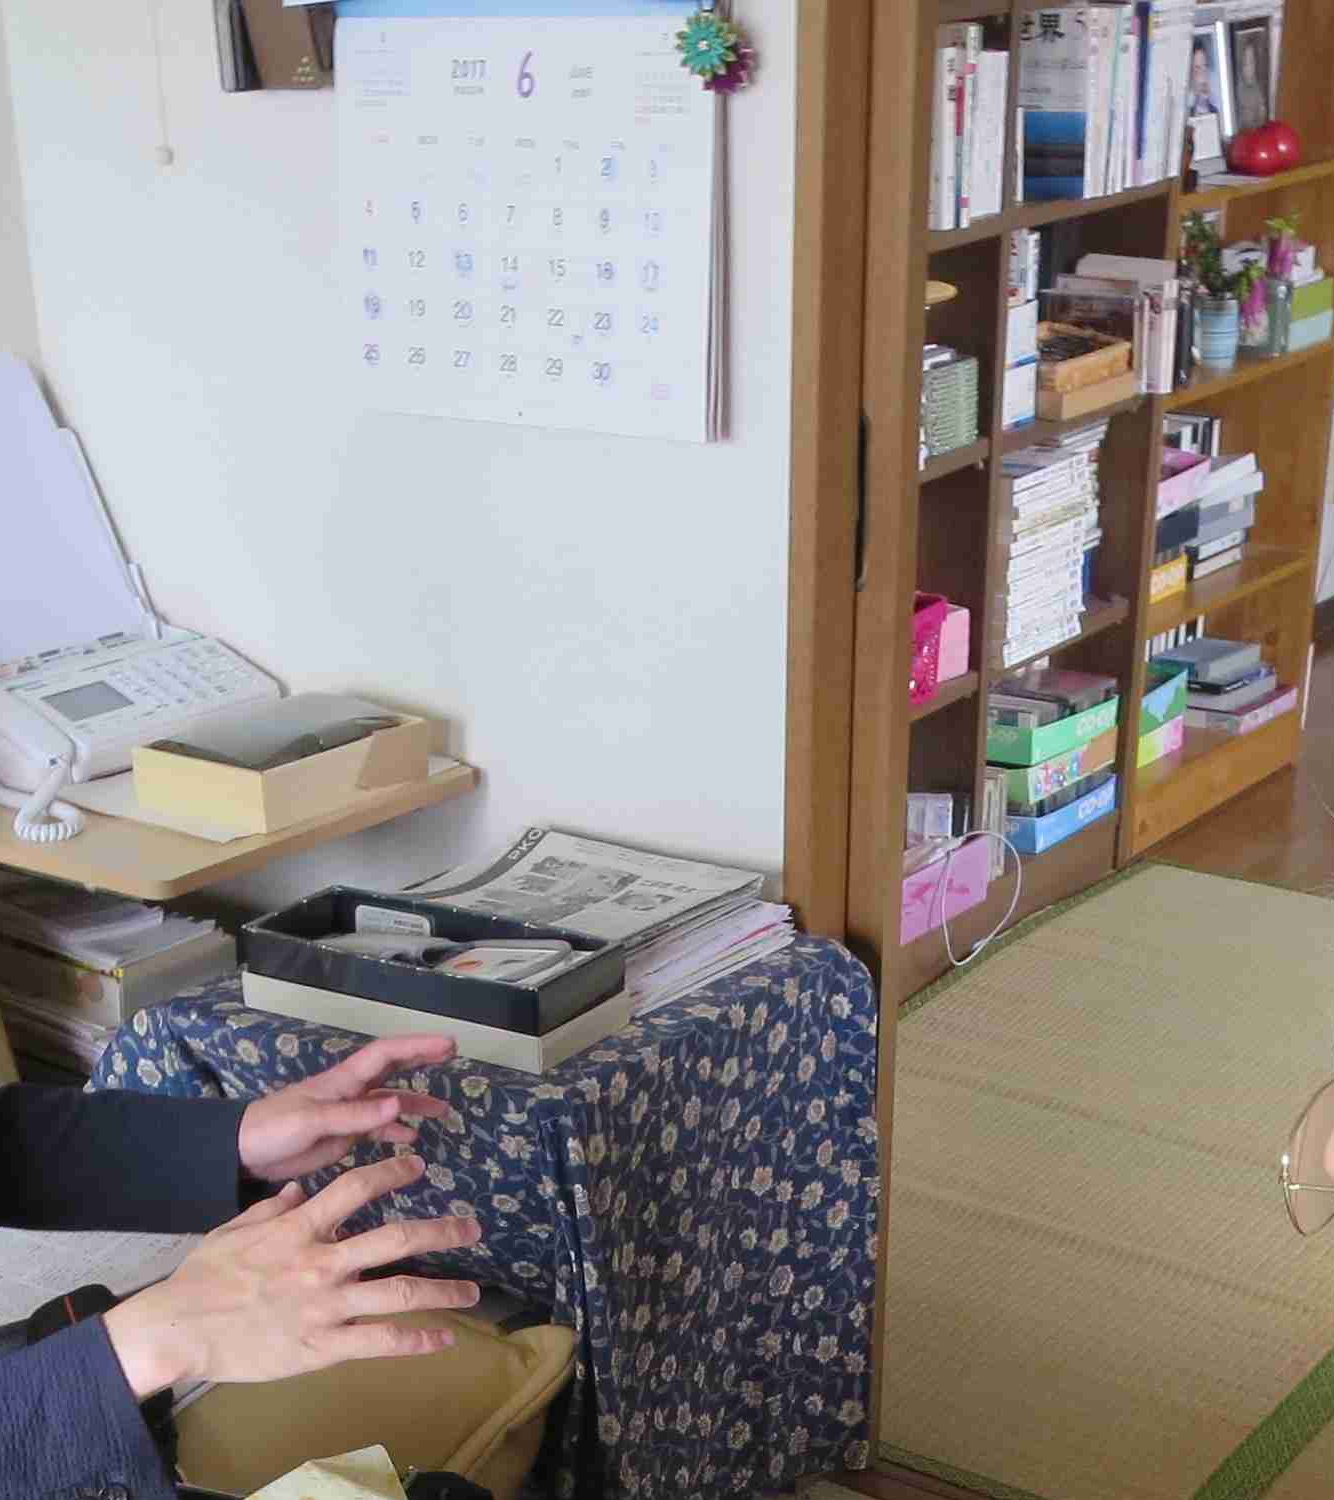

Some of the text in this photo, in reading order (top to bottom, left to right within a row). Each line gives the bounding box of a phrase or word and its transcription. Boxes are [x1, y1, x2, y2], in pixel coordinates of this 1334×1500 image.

[451, 58, 487, 79] 2017
[517, 50, 535, 98] 6
[600, 157, 613, 177] 2
[506, 204, 516, 224] 7
[408, 250, 426, 268] 12
[501, 256, 518, 273] 14
[549, 258, 566, 277] 15
[408, 299, 425, 317] 19
[454, 301, 473, 320] 20
[500, 304, 516, 323] 21
[547, 308, 564, 327] 22
[594, 312, 612, 331] 23
[454, 350, 472, 368] 27
[499, 353, 517, 372] 28
[546, 357, 564, 377] 29
[592, 361, 612, 381] 30
